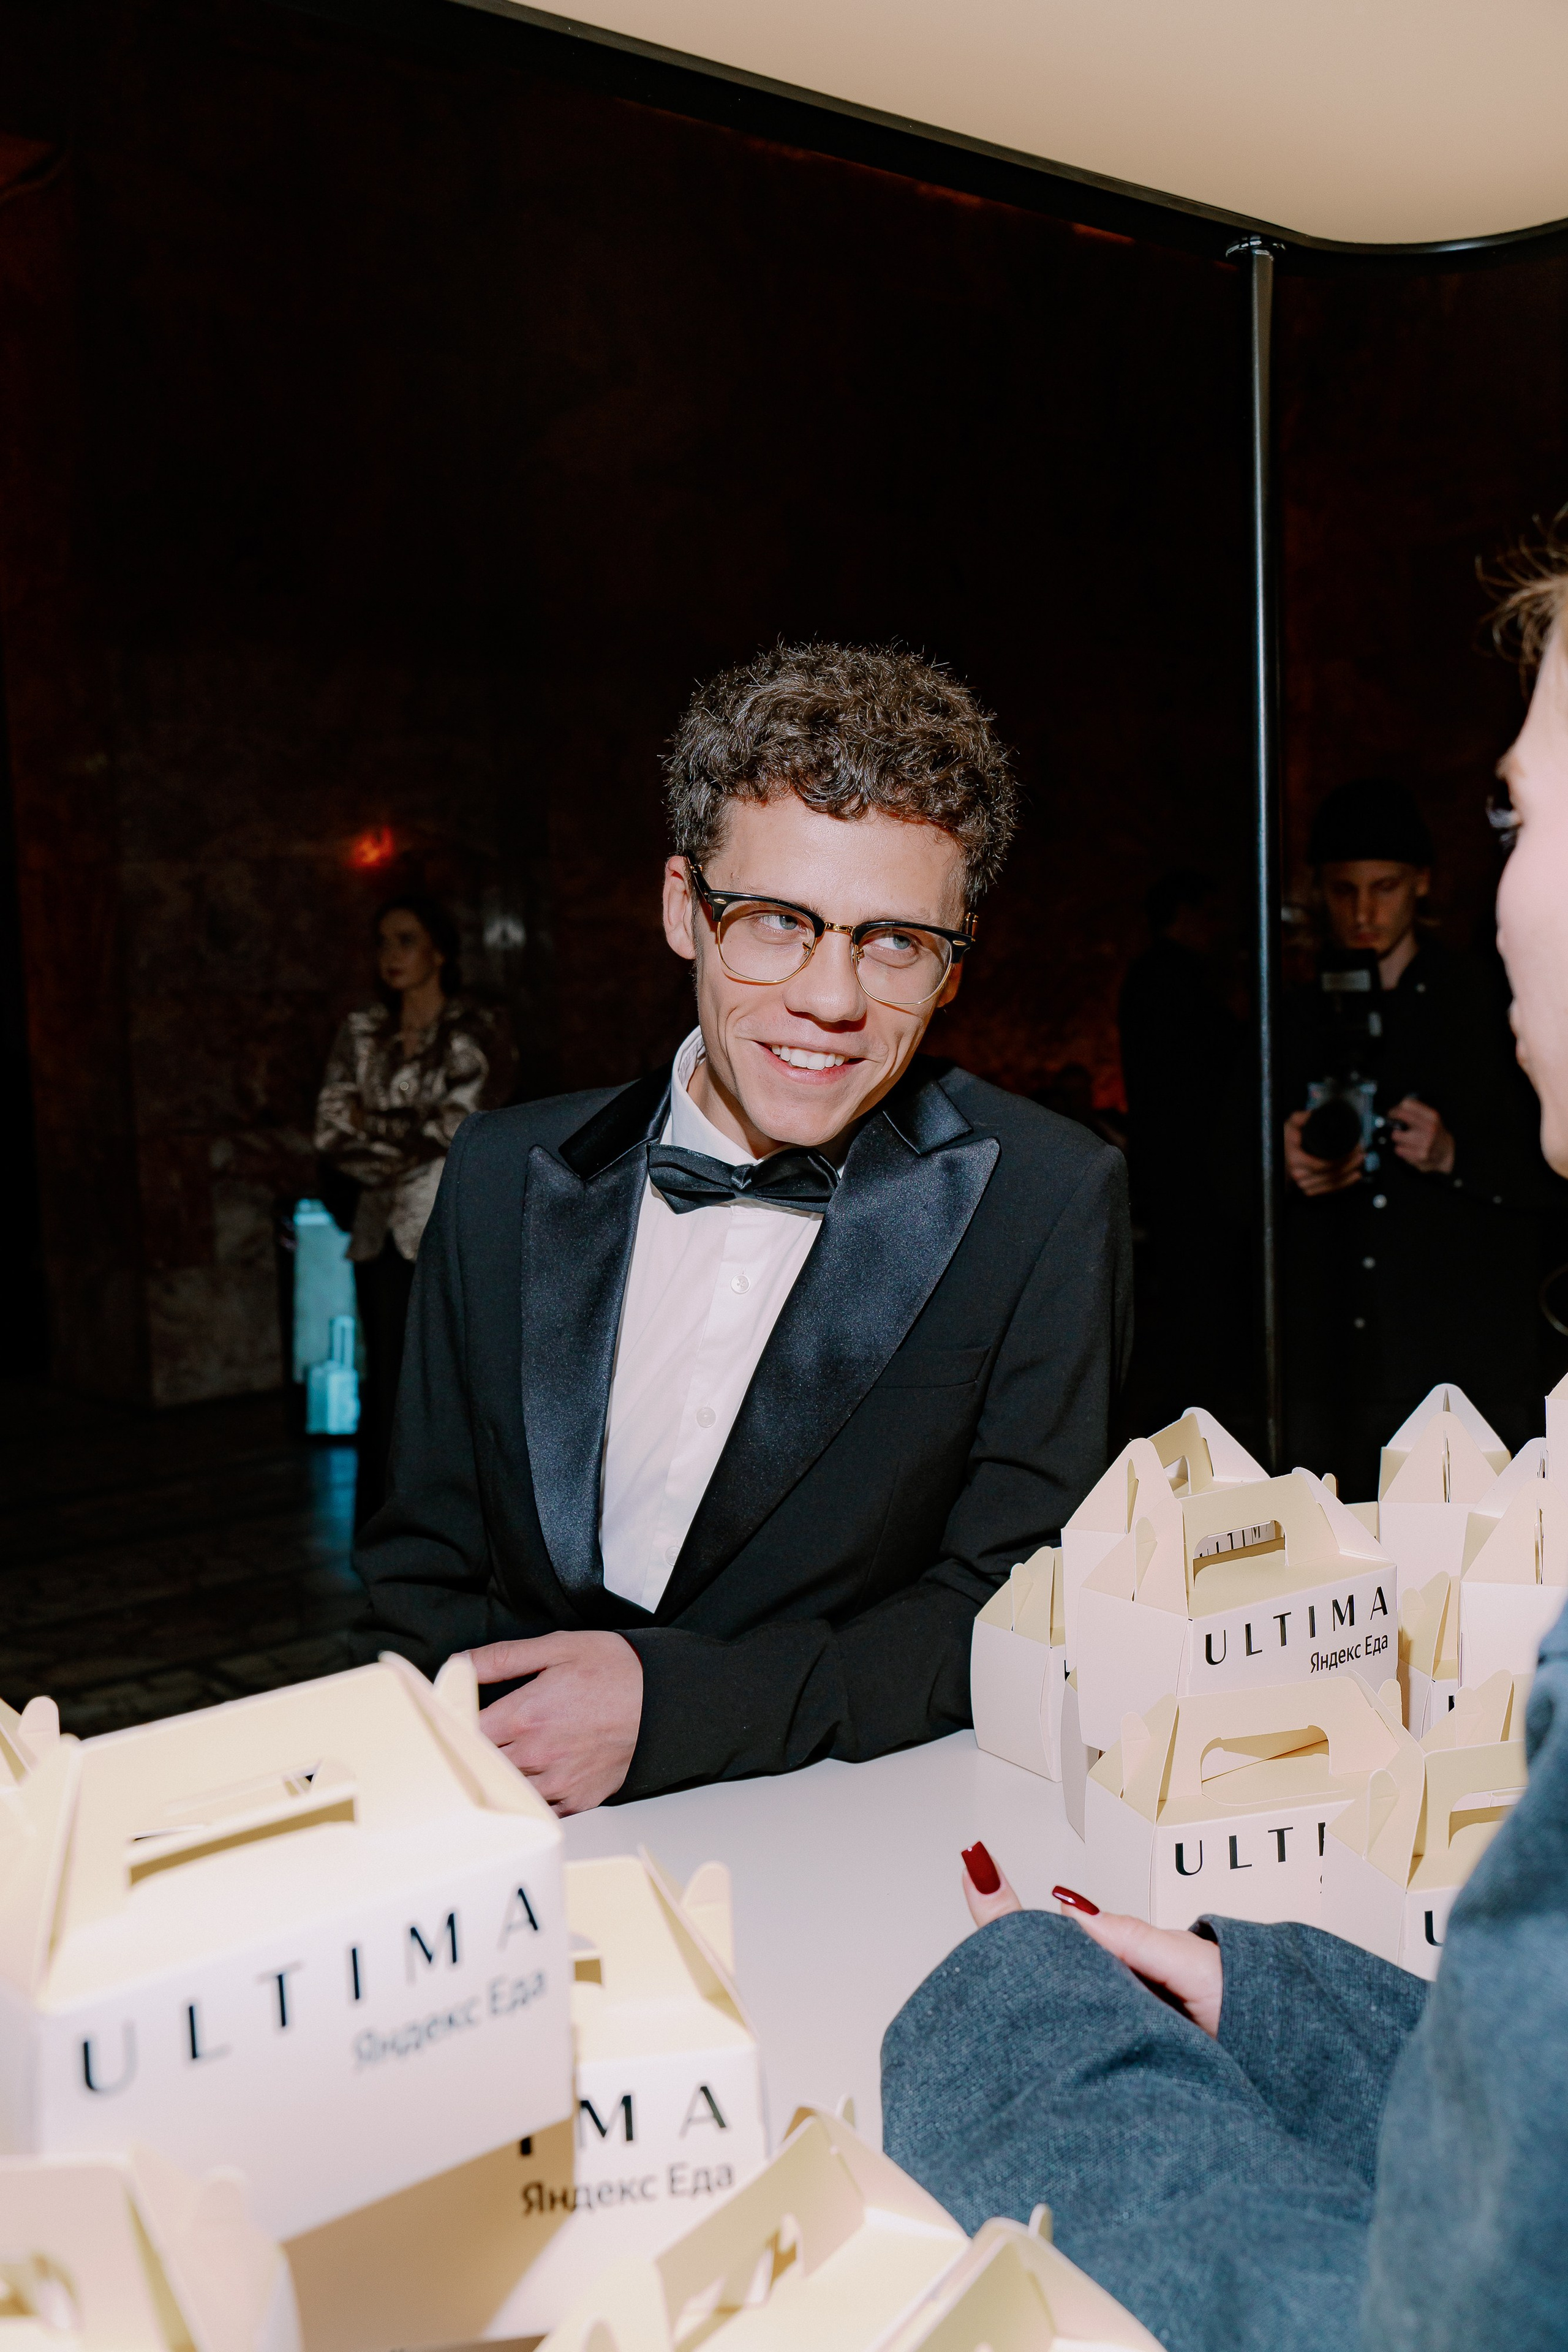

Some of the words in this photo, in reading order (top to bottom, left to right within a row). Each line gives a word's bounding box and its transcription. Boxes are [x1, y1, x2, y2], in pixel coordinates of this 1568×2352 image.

[1205, 1586, 1388, 1665] ULTIMA
[1310, 1643, 1361, 1673] Яндекс
[1365, 1634, 1388, 1656] Еда
[81, 1885, 545, 2096] ULTIMA
[353, 1999, 480, 2073] Яндекс
[488, 1969, 548, 2016] Еда
[521, 2174, 658, 2217] Яндекс
[668, 2162, 734, 2196] Еда
